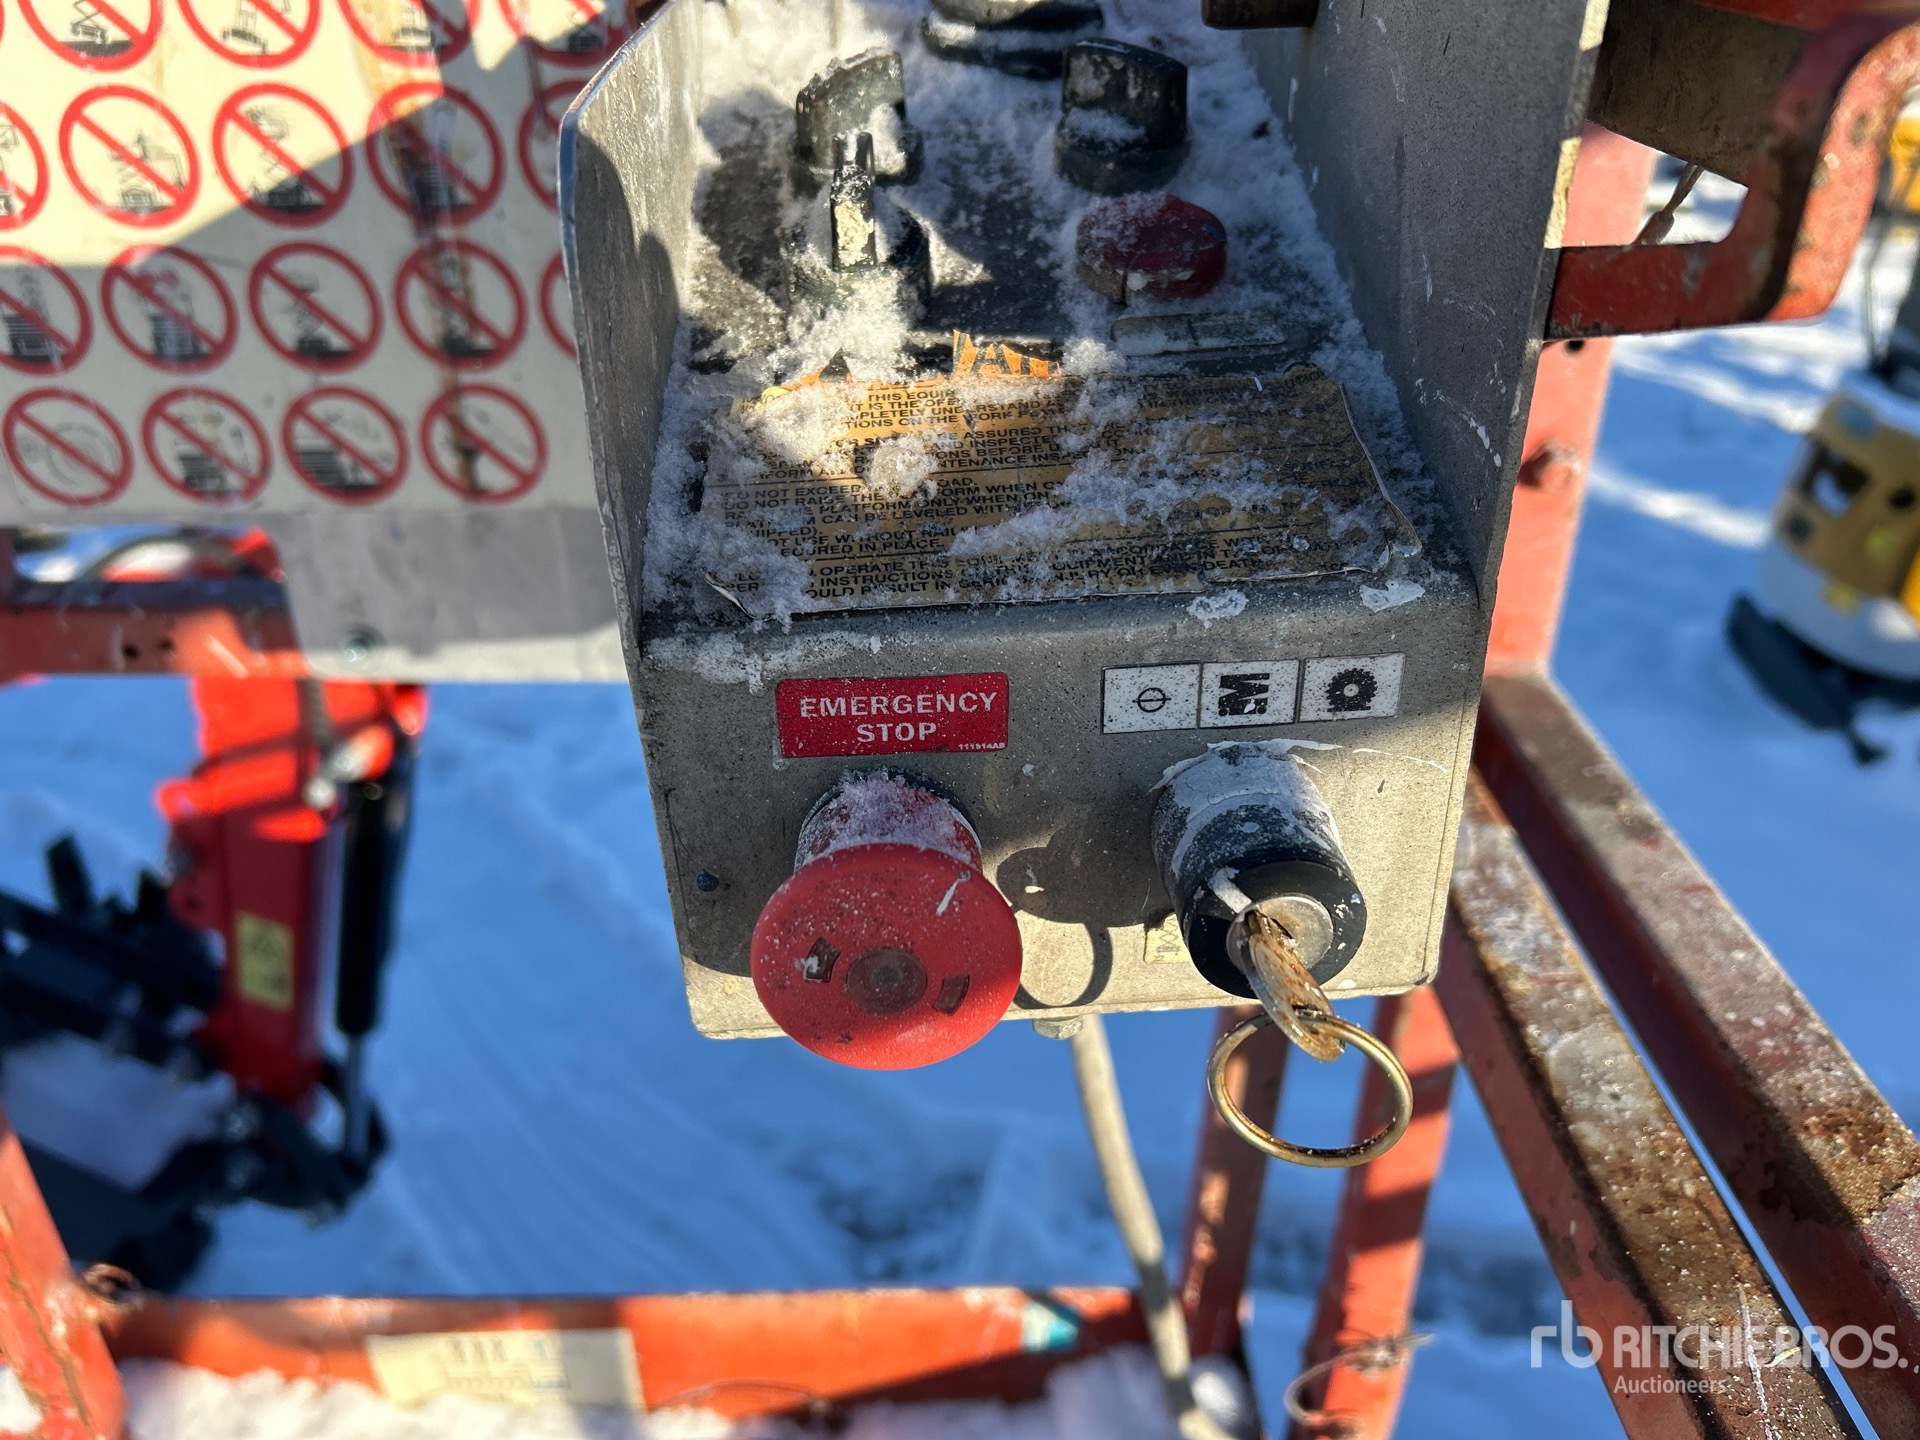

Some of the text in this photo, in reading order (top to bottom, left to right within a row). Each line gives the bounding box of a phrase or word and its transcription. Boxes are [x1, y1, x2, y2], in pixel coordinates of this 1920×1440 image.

[868, 392, 902, 402] THIS
[888, 400, 920, 409] THE
[932, 400, 1040, 415] UNDRSTAND
[927, 415, 959, 424] THE
[963, 427, 1042, 440] ASSURED
[976, 444, 1043, 457] BEFORE
[938, 455, 1027, 469] NTENANCE
[754, 498, 790, 508] NOT
[795, 494, 846, 506] RAISE
[851, 492, 884, 502] THE
[985, 481, 1038, 494] WHEN
[755, 488, 790, 499] NOT
[795, 484, 862, 497] EXCEED
[937, 477, 978, 489] OAD.
[819, 500, 911, 515] PLATFORM
[965, 493, 1018, 505] WHEN
[1023, 491, 1049, 501] ON
[821, 513, 859, 524] CAN
[865, 512, 887, 522] BE
[892, 506, 968, 520] LEVELED
[780, 545, 853, 557] ECURED
[859, 542, 877, 552] IN
[820, 561, 905, 577] OPERATE
[820, 569, 954, 588] INSTRUCTIONS
[800, 691, 998, 718] EMERGENCY
[856, 722, 937, 743] STOP
